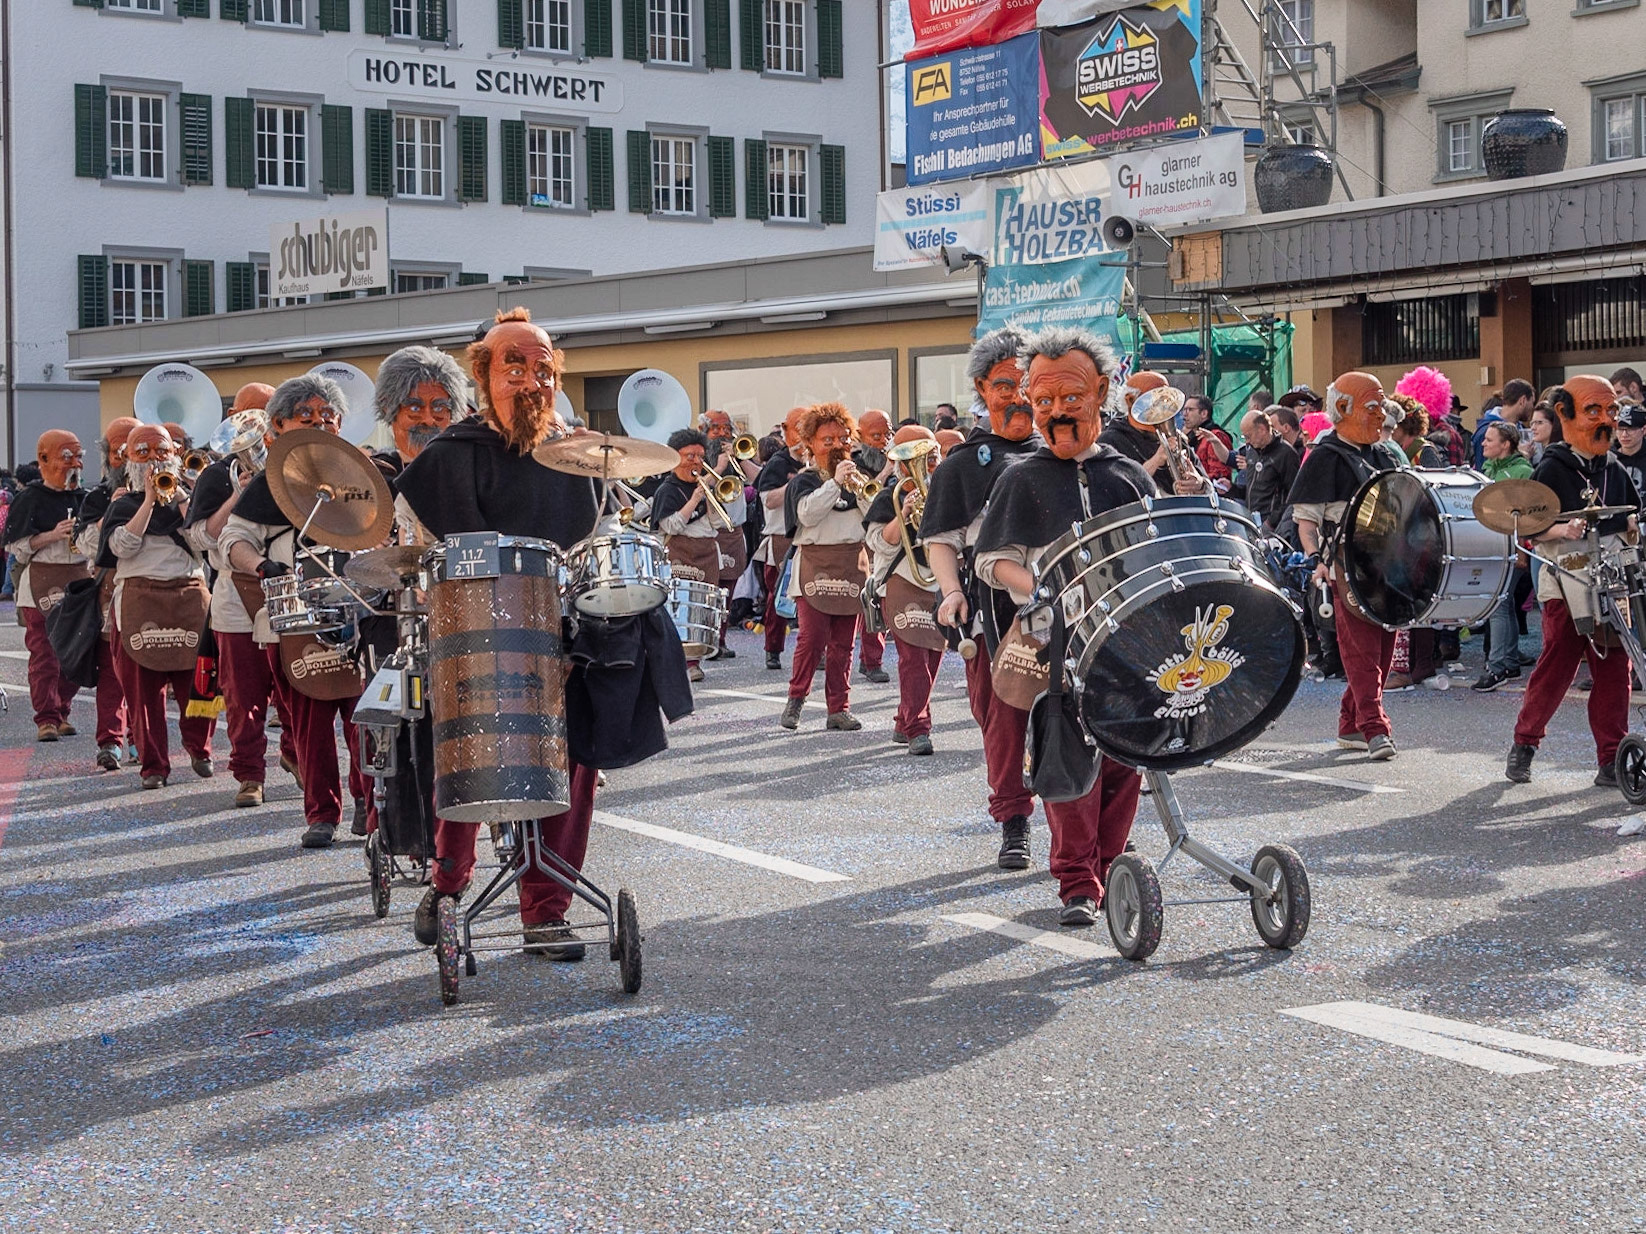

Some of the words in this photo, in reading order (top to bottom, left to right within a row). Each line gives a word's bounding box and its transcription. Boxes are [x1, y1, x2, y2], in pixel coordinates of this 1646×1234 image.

[985, 71, 995, 81] 612
[1079, 46, 1157, 83] SWISS
[365, 58, 456, 89] HOTEL
[475, 68, 605, 102] SCHWERT
[915, 68, 949, 101] FA
[959, 88, 968, 96] Fax
[985, 81, 995, 91] 612
[1080, 70, 1157, 95] WERBETECHNIK
[933, 110, 943, 122] Ihr
[944, 101, 999, 121] Ansprechpartner
[999, 96, 1009, 110] für
[939, 124, 969, 142] gesamte
[969, 113, 1016, 133] Gebäudehülle
[947, 139, 1015, 169] Bedachungen
[1017, 132, 1033, 156] AG
[1161, 154, 1202, 177] glarner
[1145, 170, 1216, 196] haustechnik
[1219, 170, 1238, 187] ag
[905, 192, 960, 217] Stüssi
[1005, 197, 1102, 240] HAUSER
[905, 227, 958, 250] Näfels
[1008, 227, 1104, 264] HOLZBA
[278, 219, 377, 288] schubiger
[278, 282, 310, 294] Kaufhaus
[351, 274, 374, 287] Näfels
[985, 274, 1081, 306] casa-technica.ch
[1103, 300, 1116, 316] AG
[447, 537, 460, 548] 3V
[1145, 653, 1186, 682] linth
[1207, 646, 1246, 669] böllä
[1153, 703, 1207, 719] glarus
